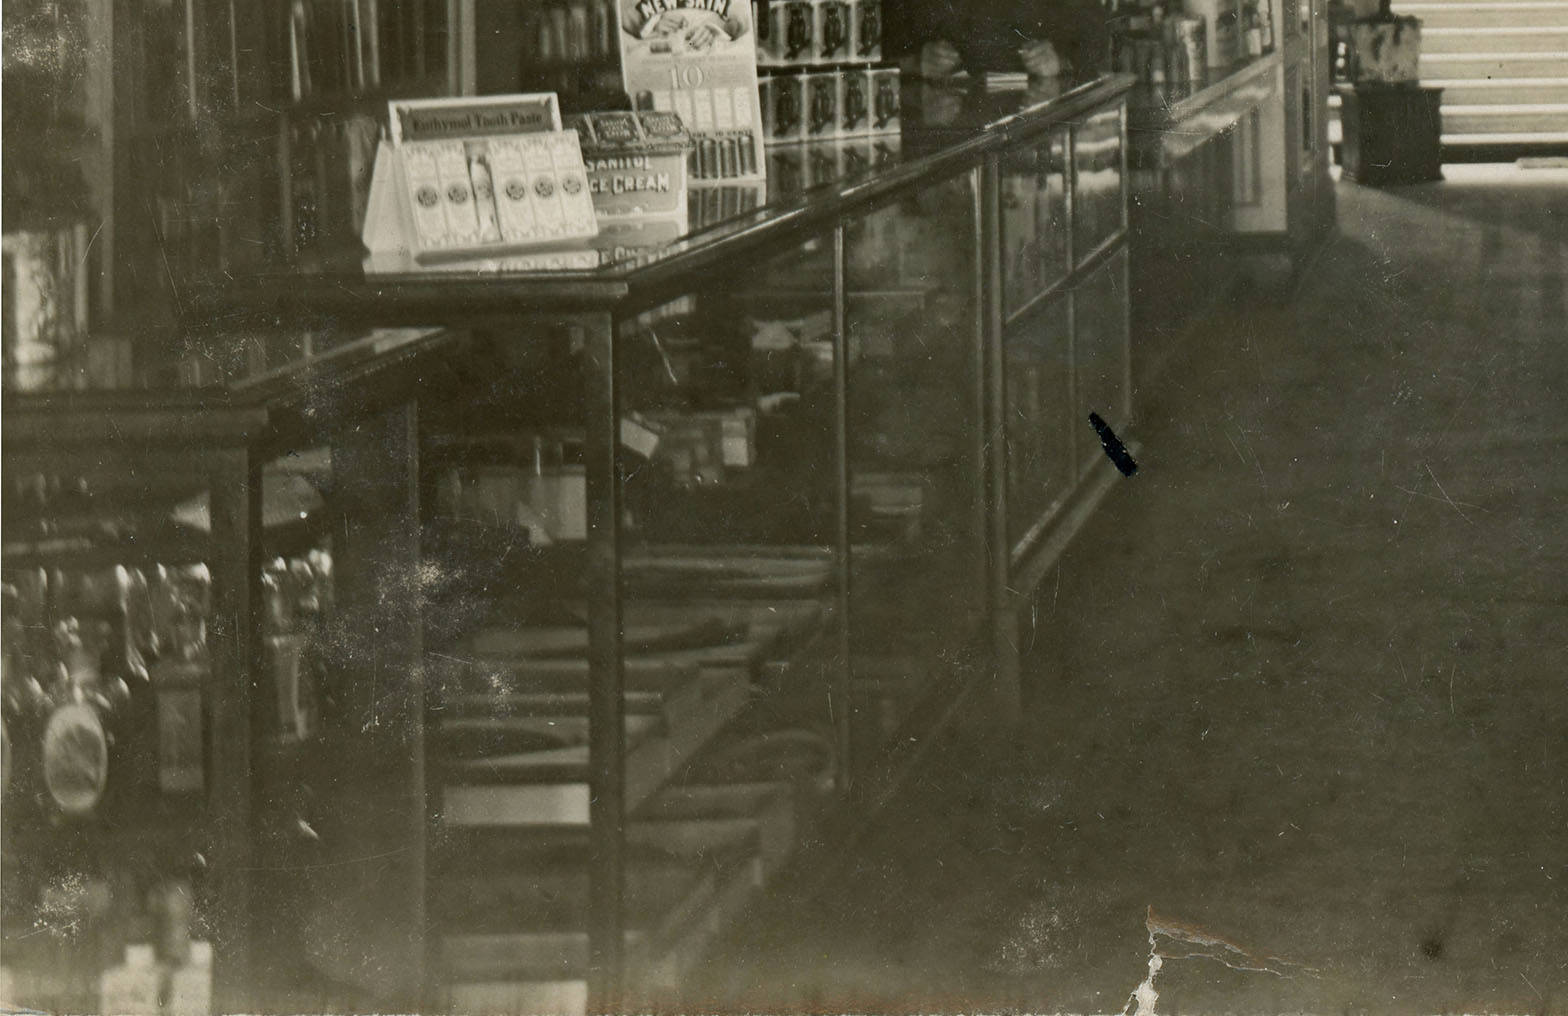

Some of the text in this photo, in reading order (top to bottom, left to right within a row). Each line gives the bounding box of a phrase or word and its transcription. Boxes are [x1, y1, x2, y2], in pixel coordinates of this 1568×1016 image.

[414, 110, 543, 132] Euthymol Tooth Paste
[589, 177, 608, 193] CE
[612, 172, 670, 195] CREAM
